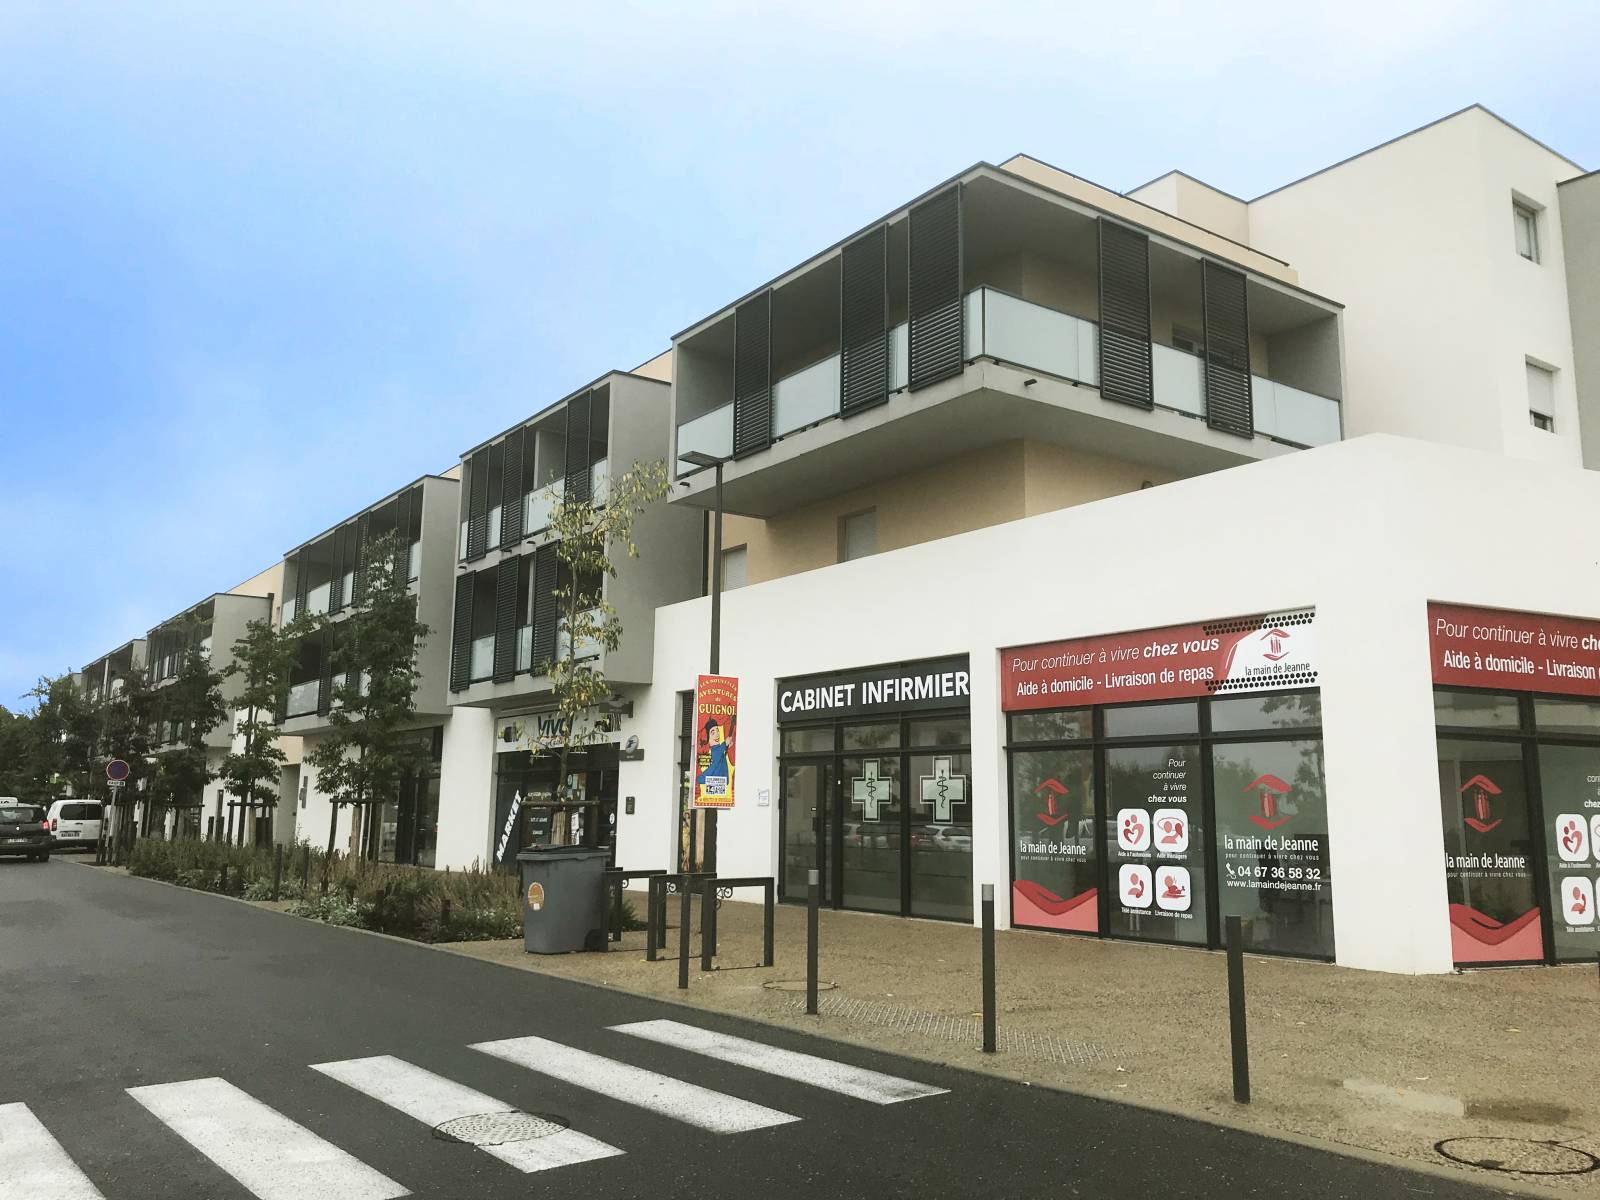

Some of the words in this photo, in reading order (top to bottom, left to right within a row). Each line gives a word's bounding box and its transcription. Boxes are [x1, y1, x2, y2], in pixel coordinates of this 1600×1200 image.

[1436, 618, 1469, 637] Pour
[1472, 624, 1535, 644] continuer
[1538, 629, 1546, 646] à
[1550, 631, 1578, 649] vivre
[1012, 658, 1039, 672] Pour
[1041, 652, 1096, 669] continuer
[1098, 647, 1106, 663] à
[1110, 646, 1140, 661] vivre
[1143, 641, 1178, 658] chez
[1183, 638, 1219, 654] vous
[1245, 666, 1251, 676] la
[1253, 665, 1271, 675] main
[1273, 663, 1282, 673] de
[1284, 662, 1310, 672] Jeanne
[1443, 650, 1470, 669] Aide
[1474, 651, 1482, 670] à
[1485, 654, 1535, 674] domicile
[1546, 659, 1596, 679] Livraison
[1017, 681, 1038, 696] Aide
[1041, 680, 1048, 694] à
[1050, 675, 1093, 693] domicile
[1105, 670, 1156, 688] Livraison
[1160, 667, 1174, 684] de
[1179, 666, 1214, 684] repas
[780, 684, 855, 713] CABINET
[862, 671, 970, 705] INFIRMIER
[699, 704, 737, 716] GUIGNOL
[1168, 758, 1186, 767] Pour
[1152, 770, 1186, 779] continuer
[1163, 782, 1168, 791] à
[1169, 782, 1187, 791] vivre
[1147, 794, 1167, 803] chez
[496, 789, 521, 862] MARKET
[1020, 840, 1026, 853] la
[1028, 841, 1047, 853] main
[1048, 841, 1057, 854] de
[1059, 841, 1086, 855] Jeanne
[1224, 834, 1233, 849] la
[1236, 835, 1262, 850] main
[1264, 835, 1277, 850] de
[1280, 835, 1319, 851] Jeanne
[1445, 852, 1454, 868] la
[1456, 853, 1479, 868] main
[1481, 852, 1492, 868] de
[1494, 852, 1525, 868] Jeanne
[1237, 866, 1251, 877] 04
[1254, 866, 1268, 877] 67
[1271, 867, 1285, 878] 36
[1288, 868, 1302, 879] 58
[1306, 868, 1320, 880] 32
[1226, 880, 1322, 891] www.lamaindejeanne.fr
